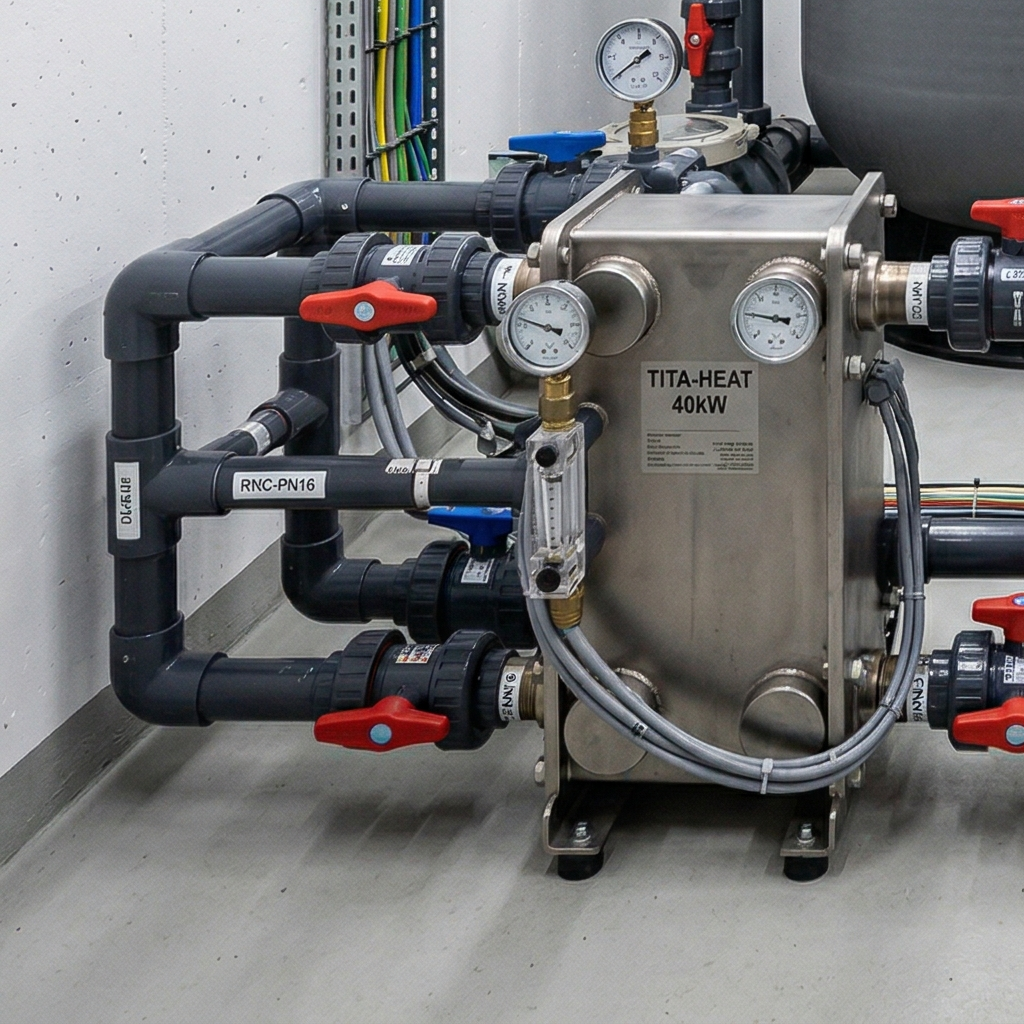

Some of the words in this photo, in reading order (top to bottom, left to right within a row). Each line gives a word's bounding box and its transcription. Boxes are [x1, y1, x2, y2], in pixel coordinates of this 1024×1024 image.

[647, 369, 753, 388] TITA-HEAT
[672, 395, 728, 414] 40kW
[241, 478, 315, 492] RNC-PN16
